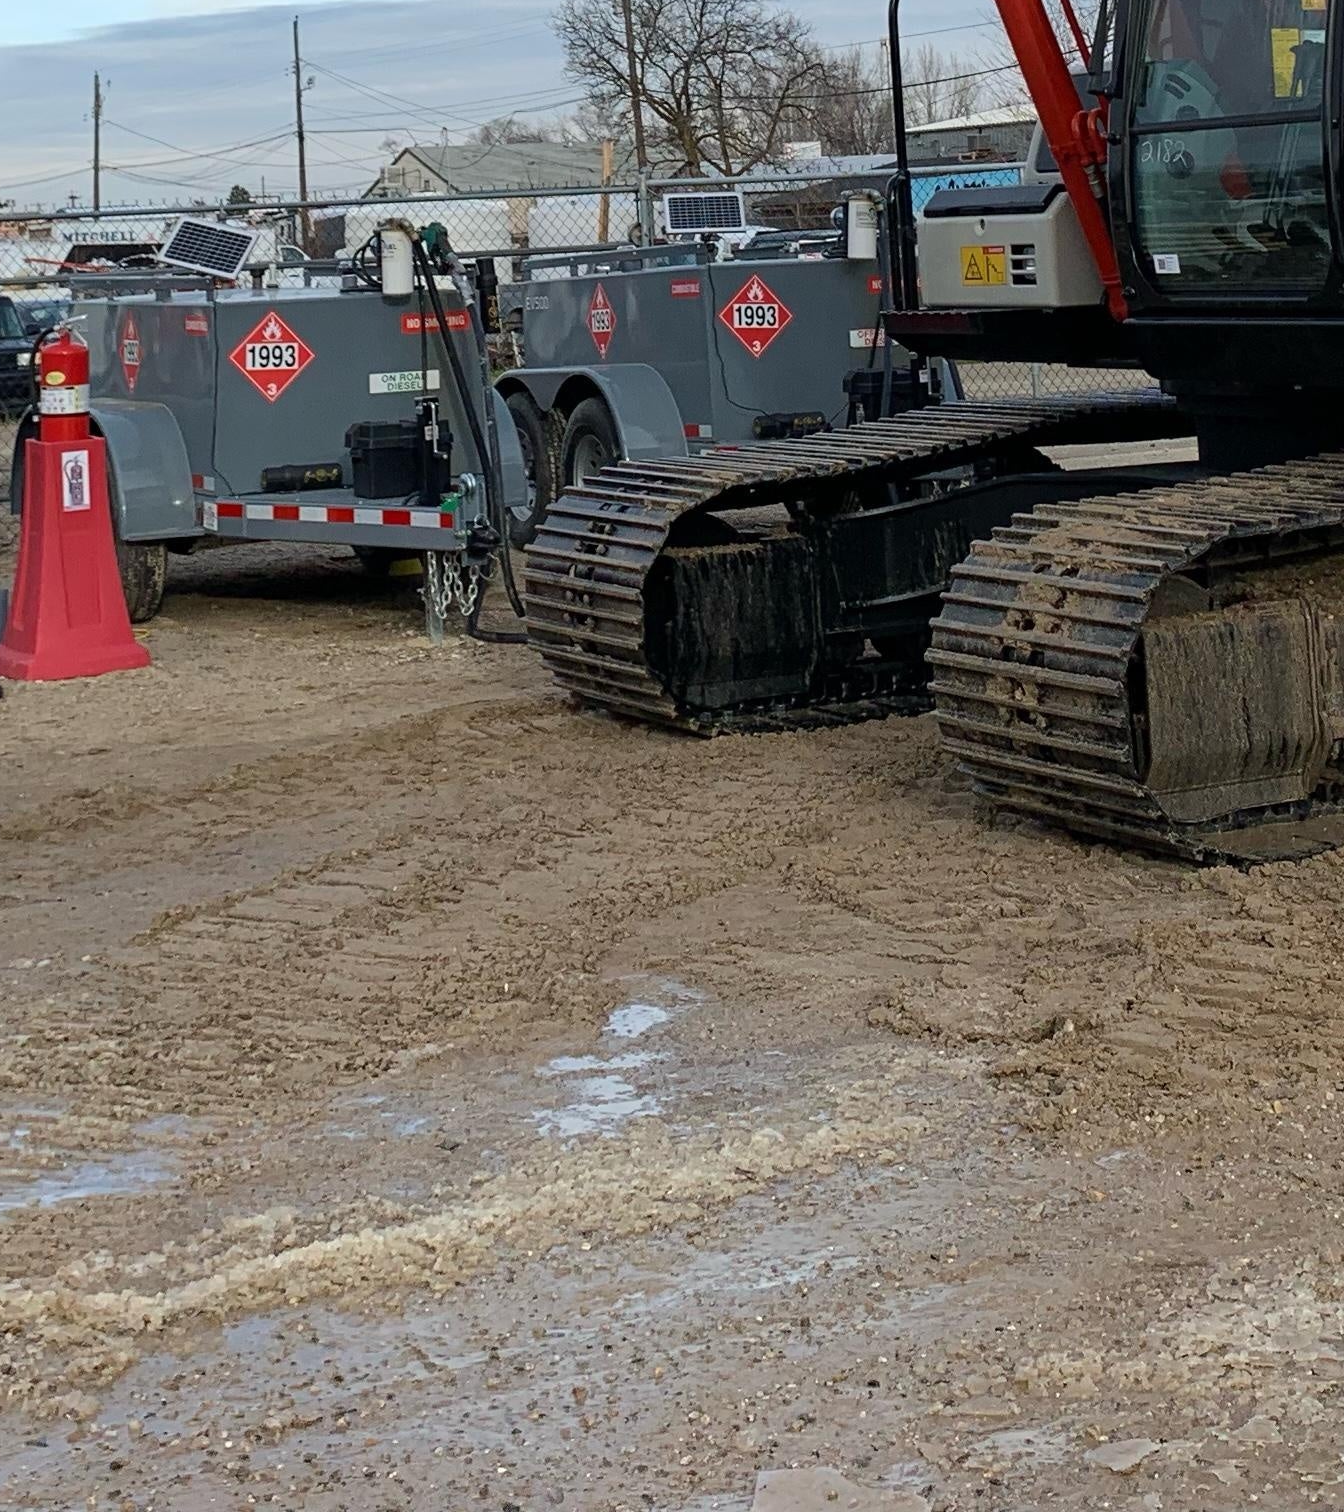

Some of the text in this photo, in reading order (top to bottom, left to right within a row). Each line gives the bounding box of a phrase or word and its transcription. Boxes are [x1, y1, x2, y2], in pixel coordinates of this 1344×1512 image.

[1141, 139, 1188, 169] 2182
[62, 231, 136, 242] MITCHELL
[735, 305, 778, 327] 1993
[406, 318, 420, 329] NO
[752, 340, 761, 351] 3
[248, 344, 296, 368] 1993
[381, 372, 423, 383] ON ROA
[267, 383, 278, 396] 3
[387, 381, 422, 391] DIESEL
